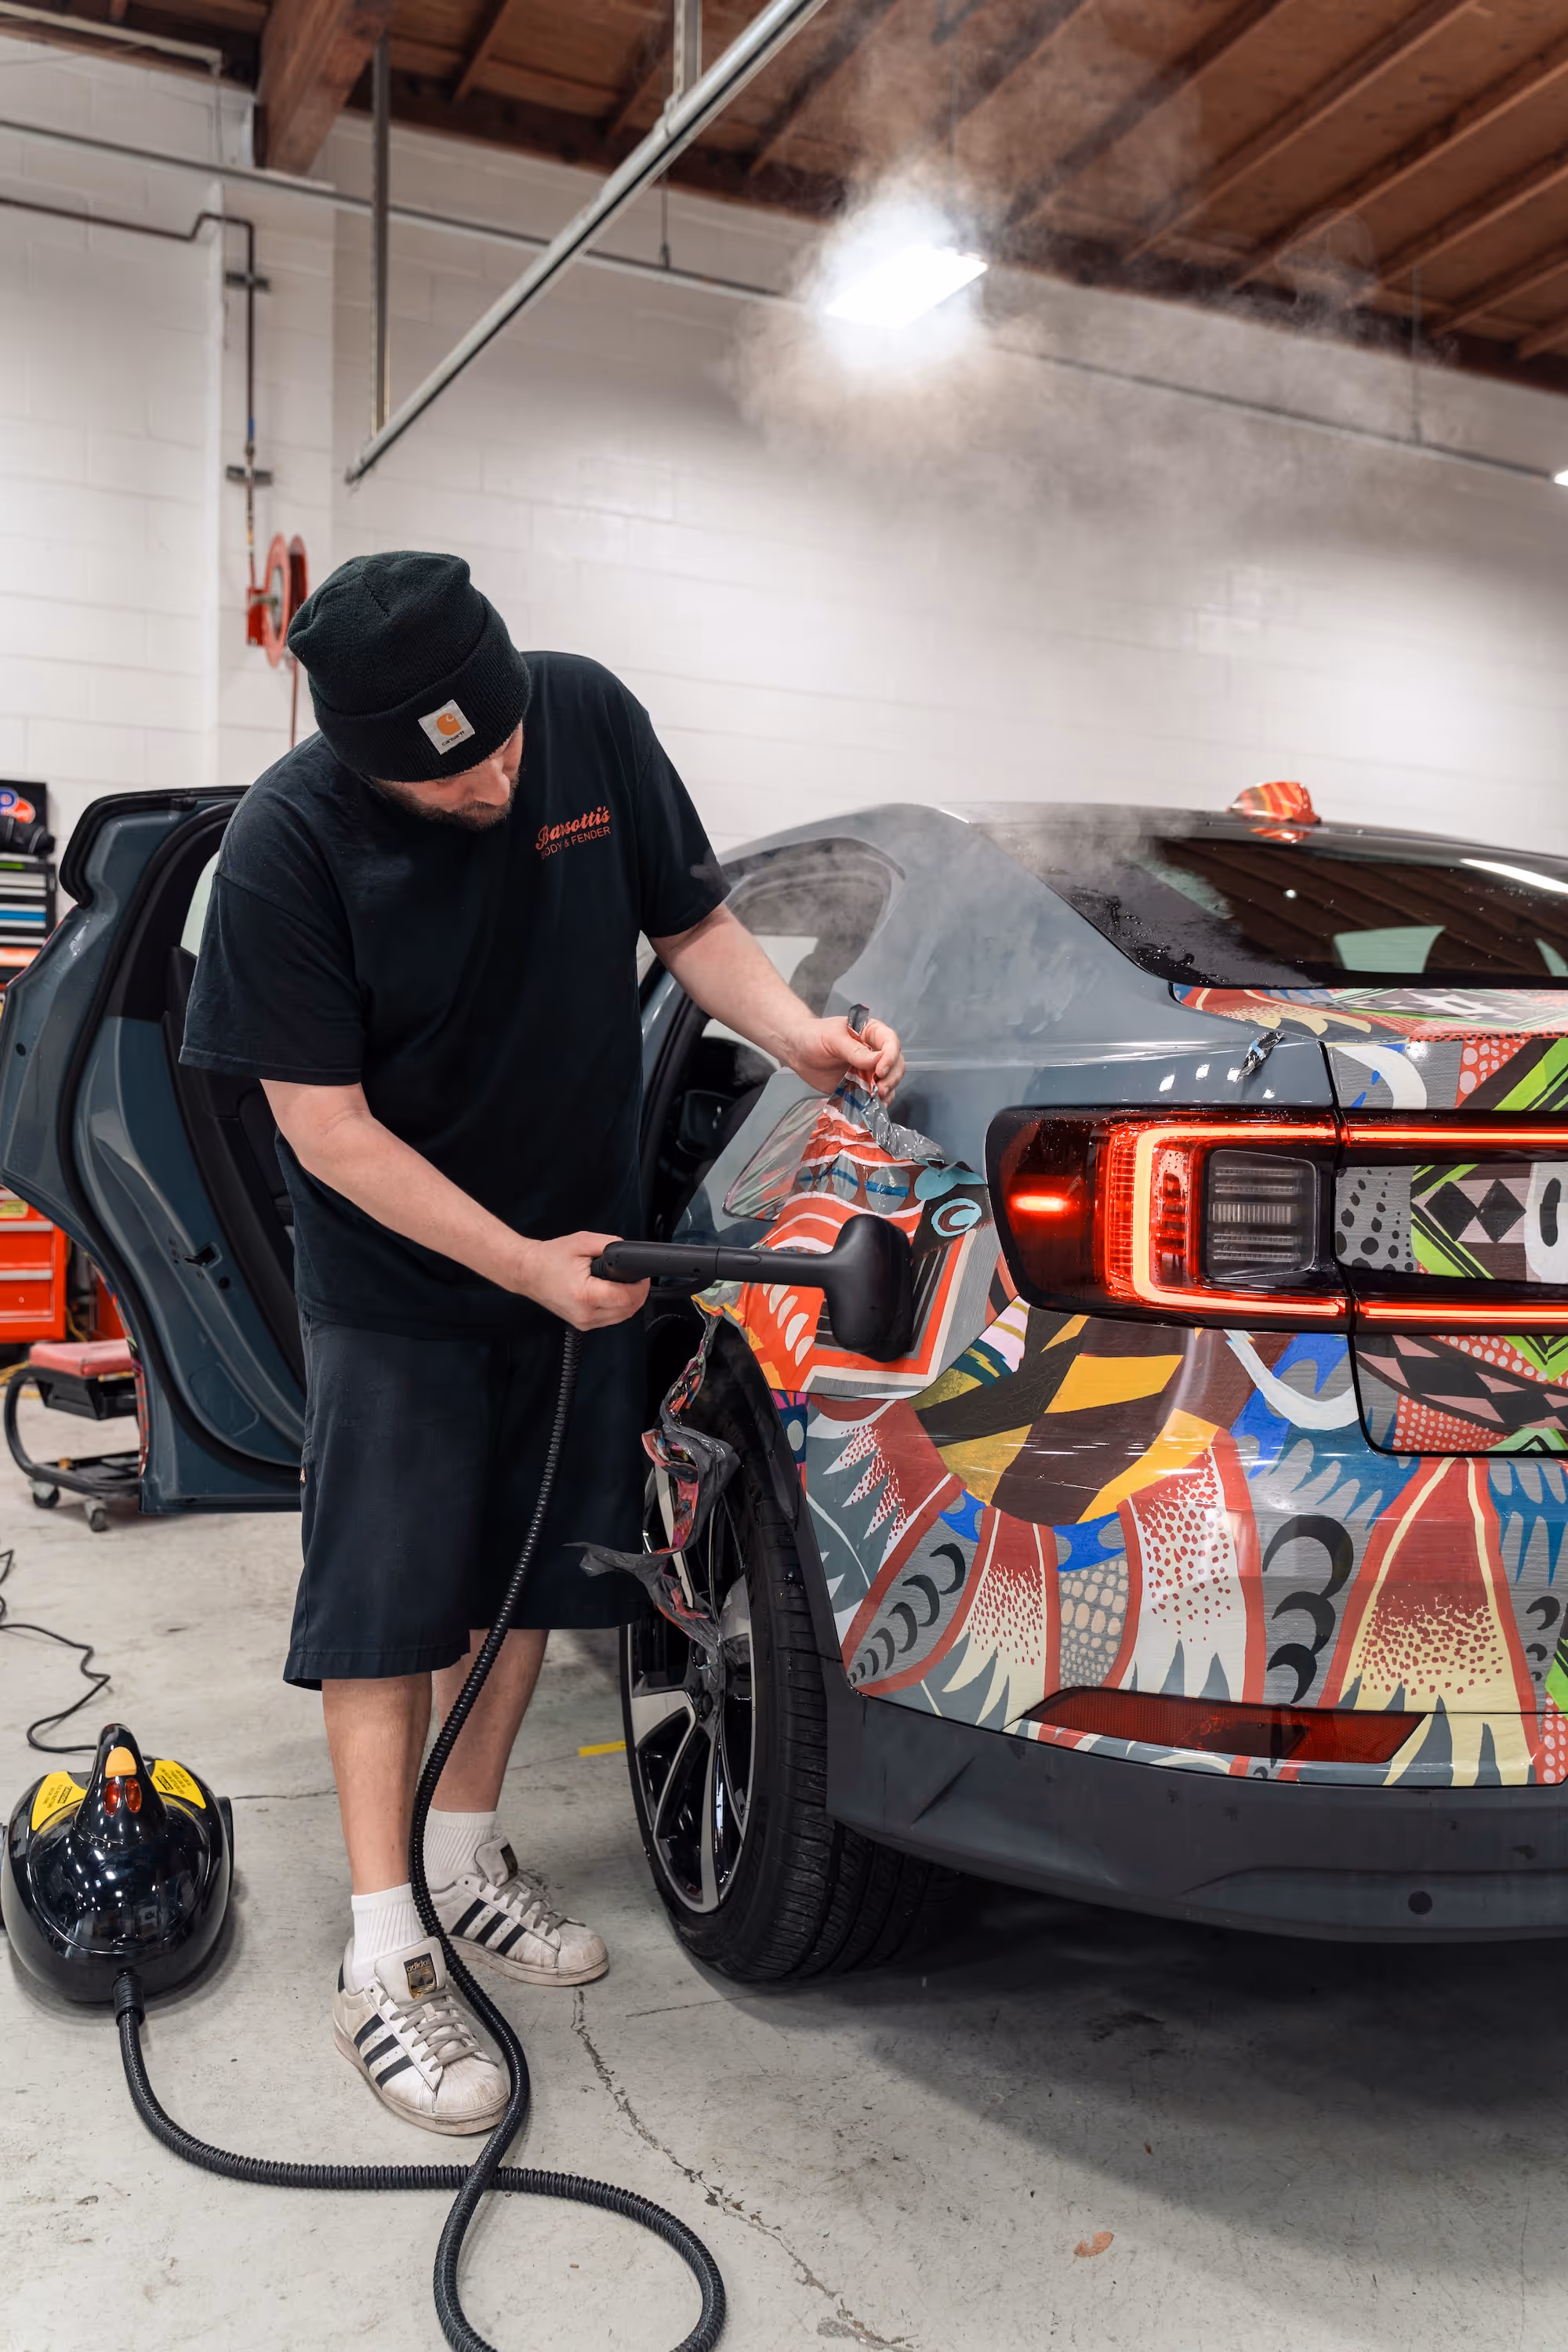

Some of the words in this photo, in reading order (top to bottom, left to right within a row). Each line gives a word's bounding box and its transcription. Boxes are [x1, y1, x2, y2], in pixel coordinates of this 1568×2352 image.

[535, 806, 610, 850] Barsotti's
[541, 841, 562, 859] BODY
[564, 838, 570, 848] &
[571, 826, 612, 845] FENDER
